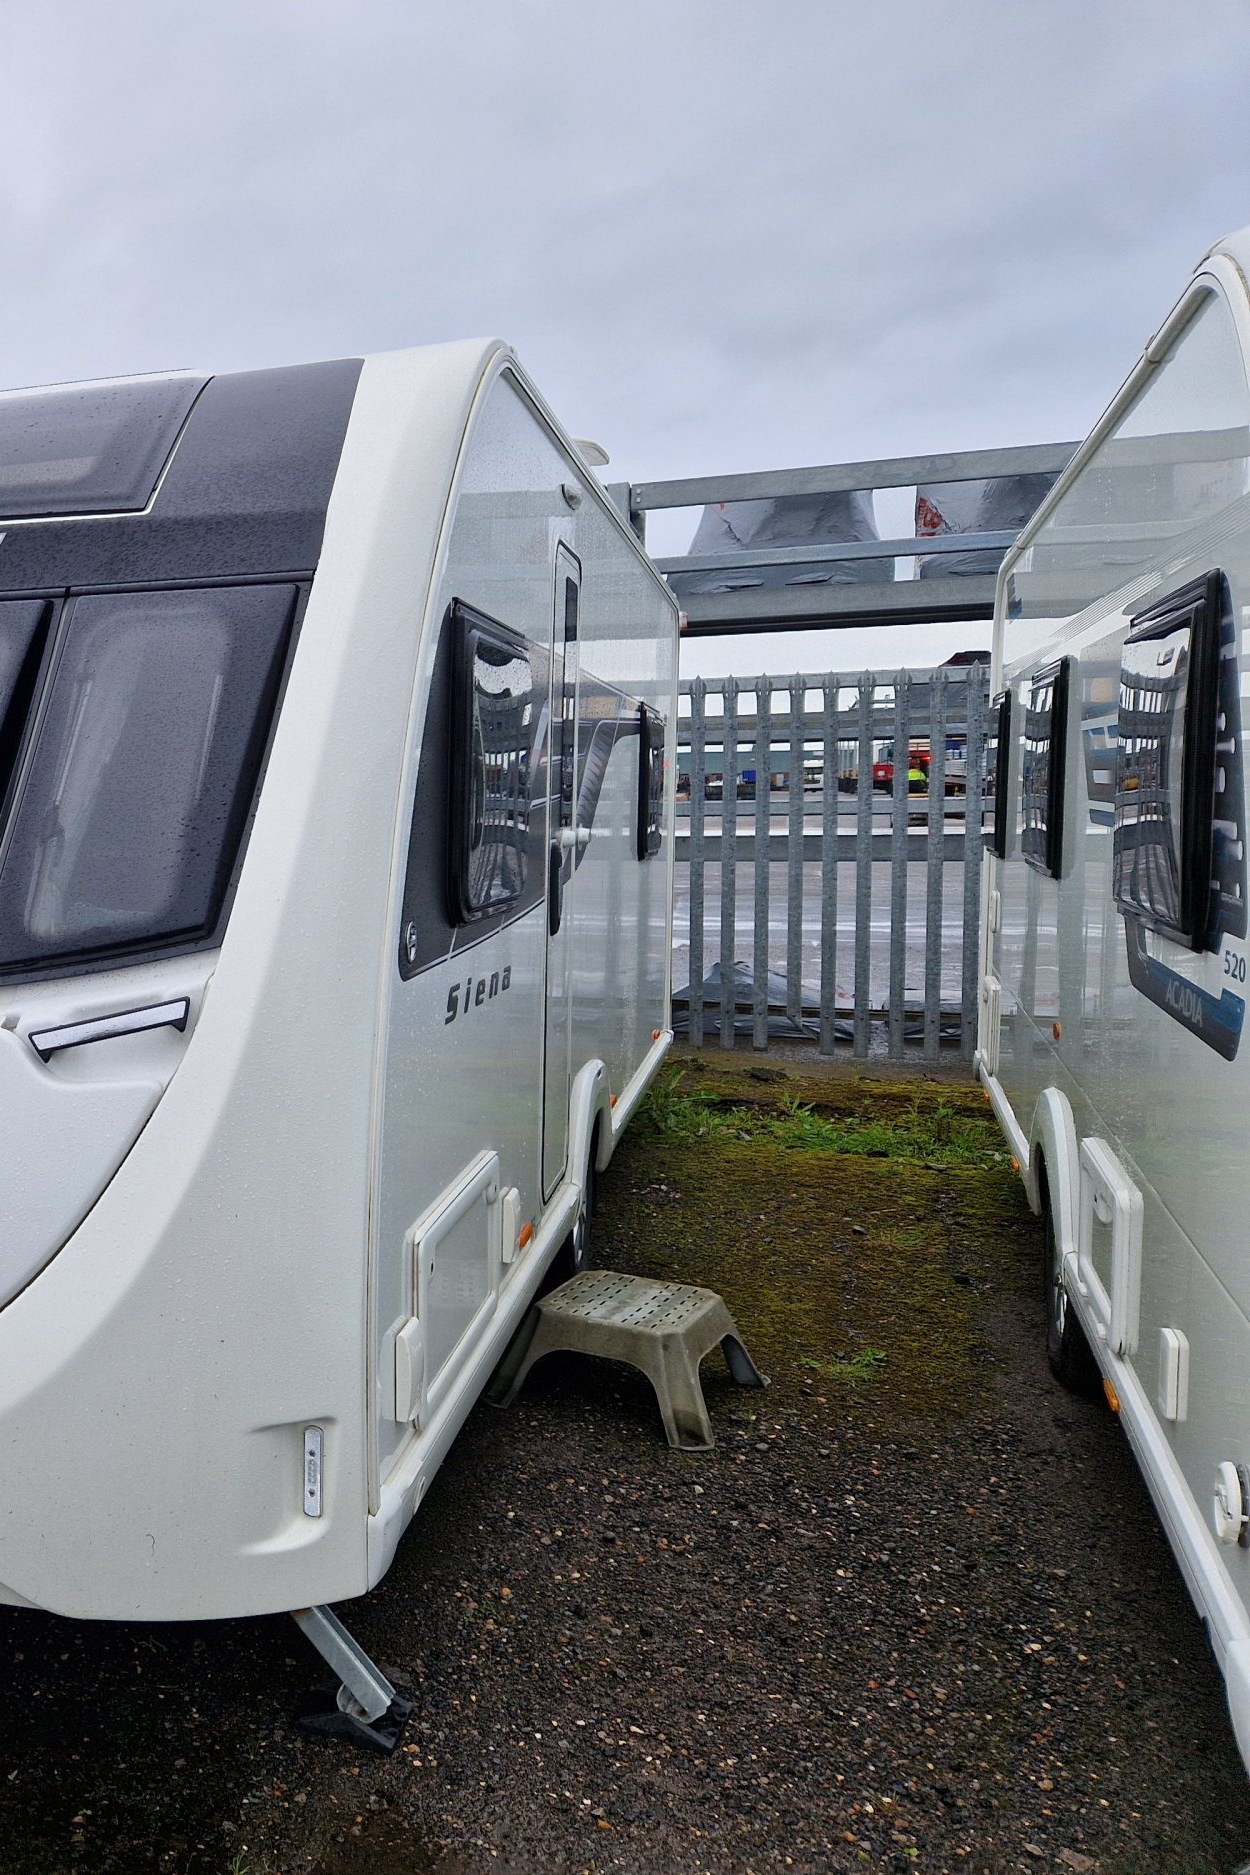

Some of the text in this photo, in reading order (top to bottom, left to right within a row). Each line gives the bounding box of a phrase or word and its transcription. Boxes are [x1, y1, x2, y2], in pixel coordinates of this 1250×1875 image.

[1224, 949, 1247, 983] 520
[444, 965, 512, 1026] Siena
[1165, 977, 1203, 1029] ACADIA
